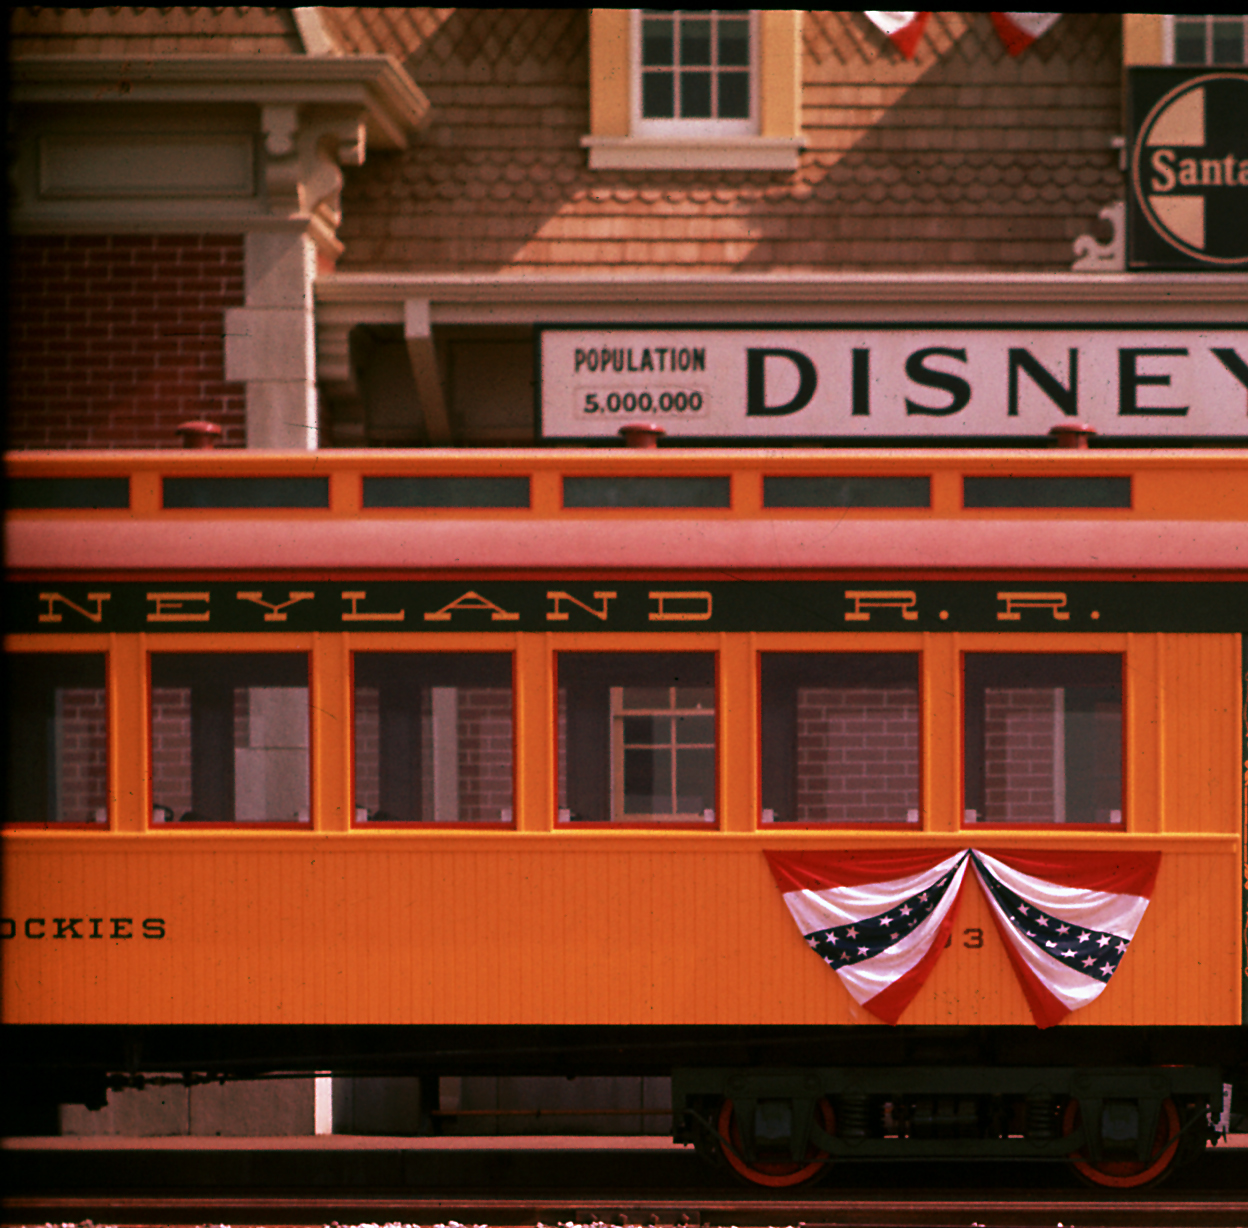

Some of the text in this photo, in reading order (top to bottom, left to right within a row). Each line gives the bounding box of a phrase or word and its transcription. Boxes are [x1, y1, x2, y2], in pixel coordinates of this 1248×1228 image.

[574, 347, 706, 373] POPULATION
[39, 589, 1101, 623] NEYLAND R. R.
